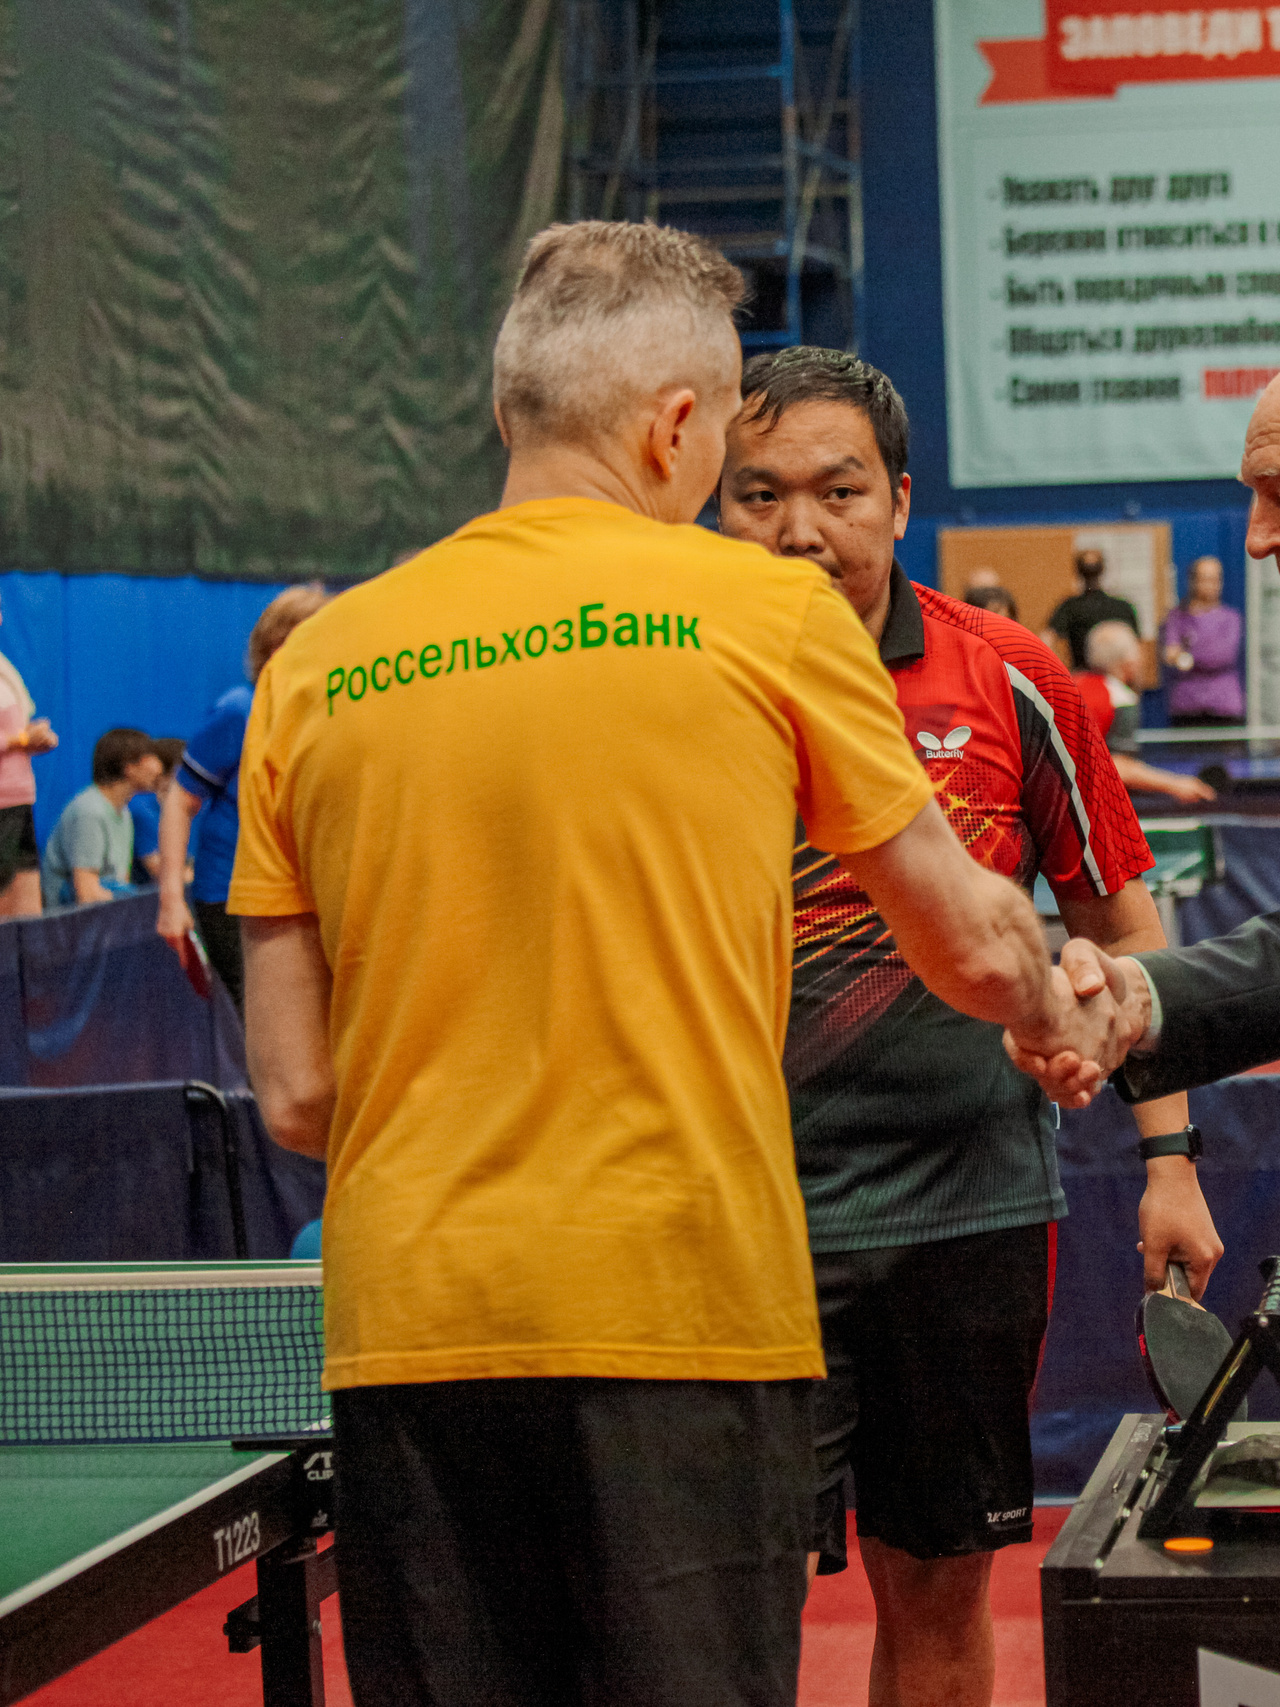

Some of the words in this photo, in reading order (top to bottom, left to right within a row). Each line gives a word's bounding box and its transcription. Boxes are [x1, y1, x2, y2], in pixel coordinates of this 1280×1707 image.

[925, 748, 965, 760] Butterfly
[1001, 1507, 1027, 1521] SPORT
[213, 1511, 261, 1572] T1223
